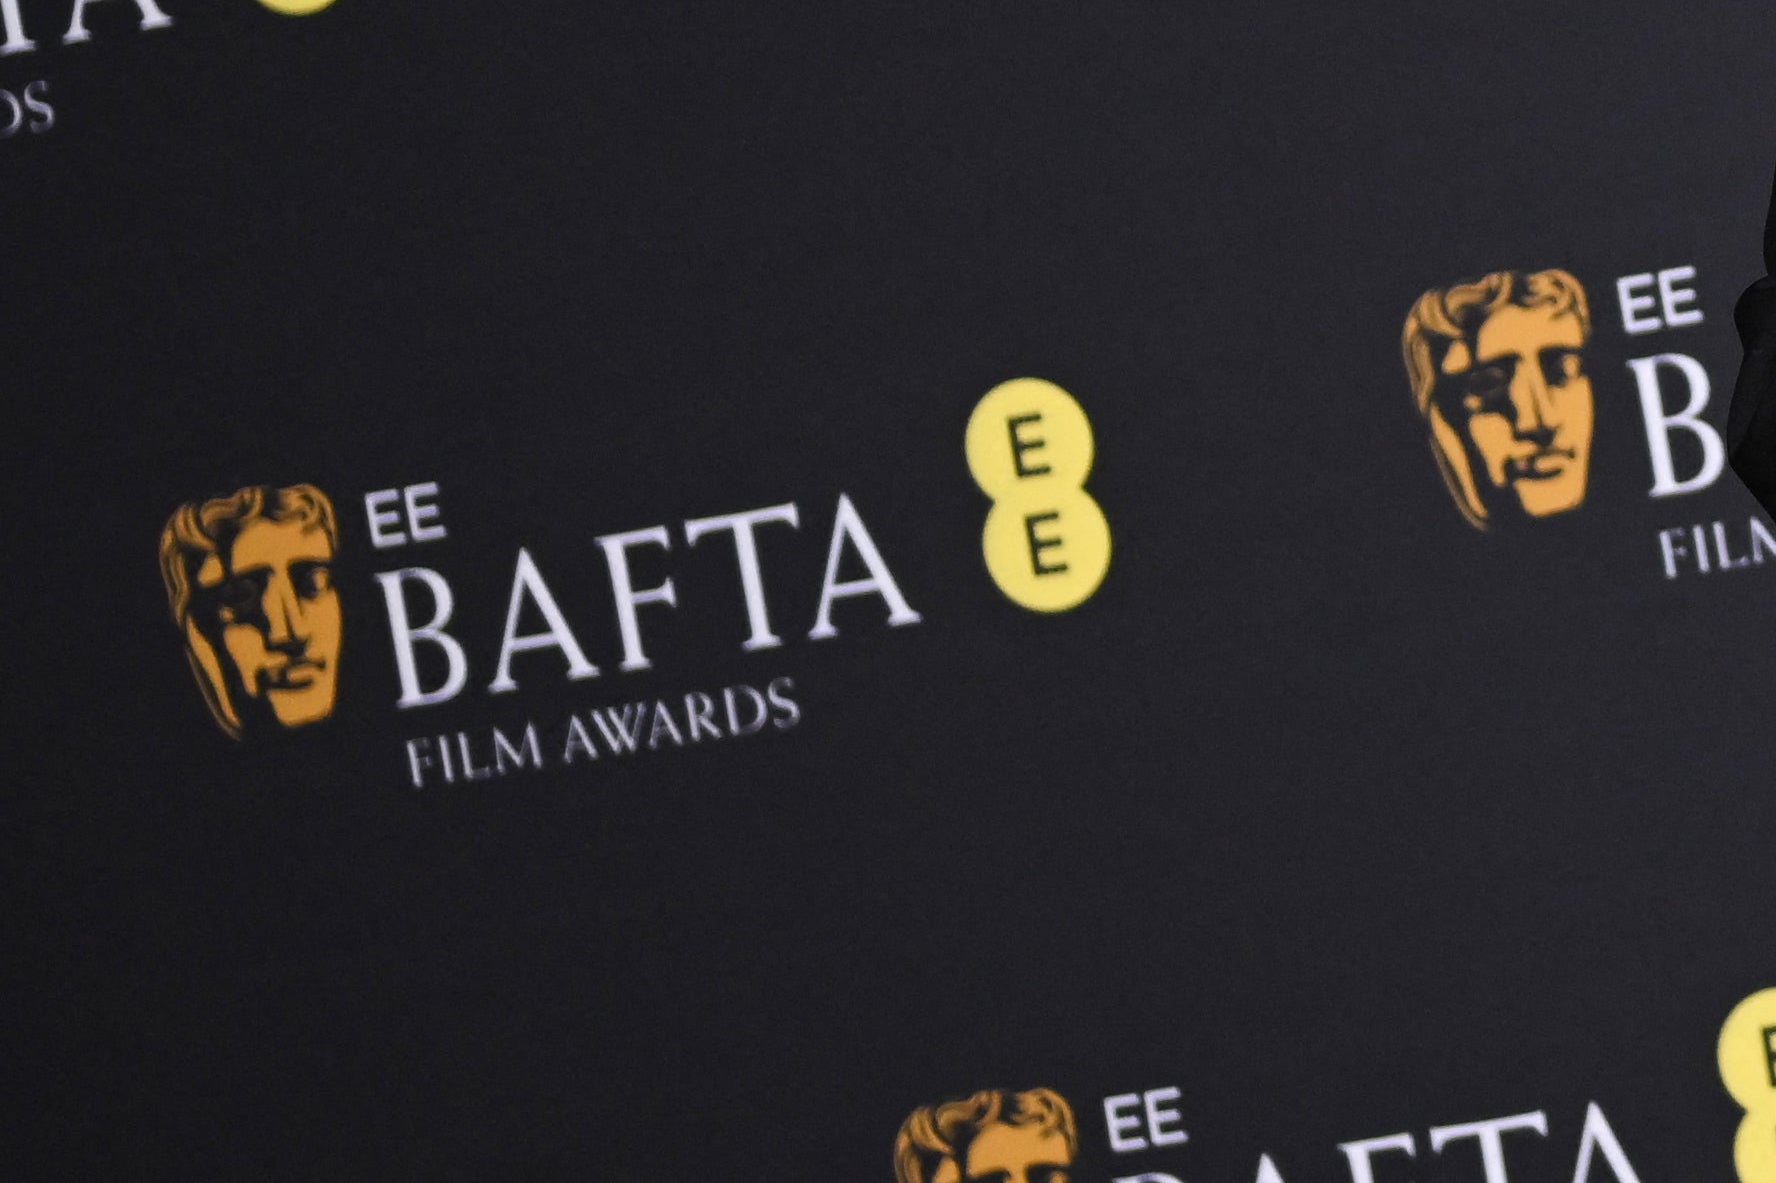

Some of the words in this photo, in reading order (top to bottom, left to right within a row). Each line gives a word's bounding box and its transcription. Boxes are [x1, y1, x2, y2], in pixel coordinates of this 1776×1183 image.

[1614, 264, 1705, 336] EE
[1624, 351, 1727, 499] B
[363, 480, 448, 549] EE
[375, 492, 922, 709] BAFTA
[405, 722, 543, 788] FILM
[563, 676, 801, 761] AWARDS
[1102, 1085, 1190, 1154] EE
